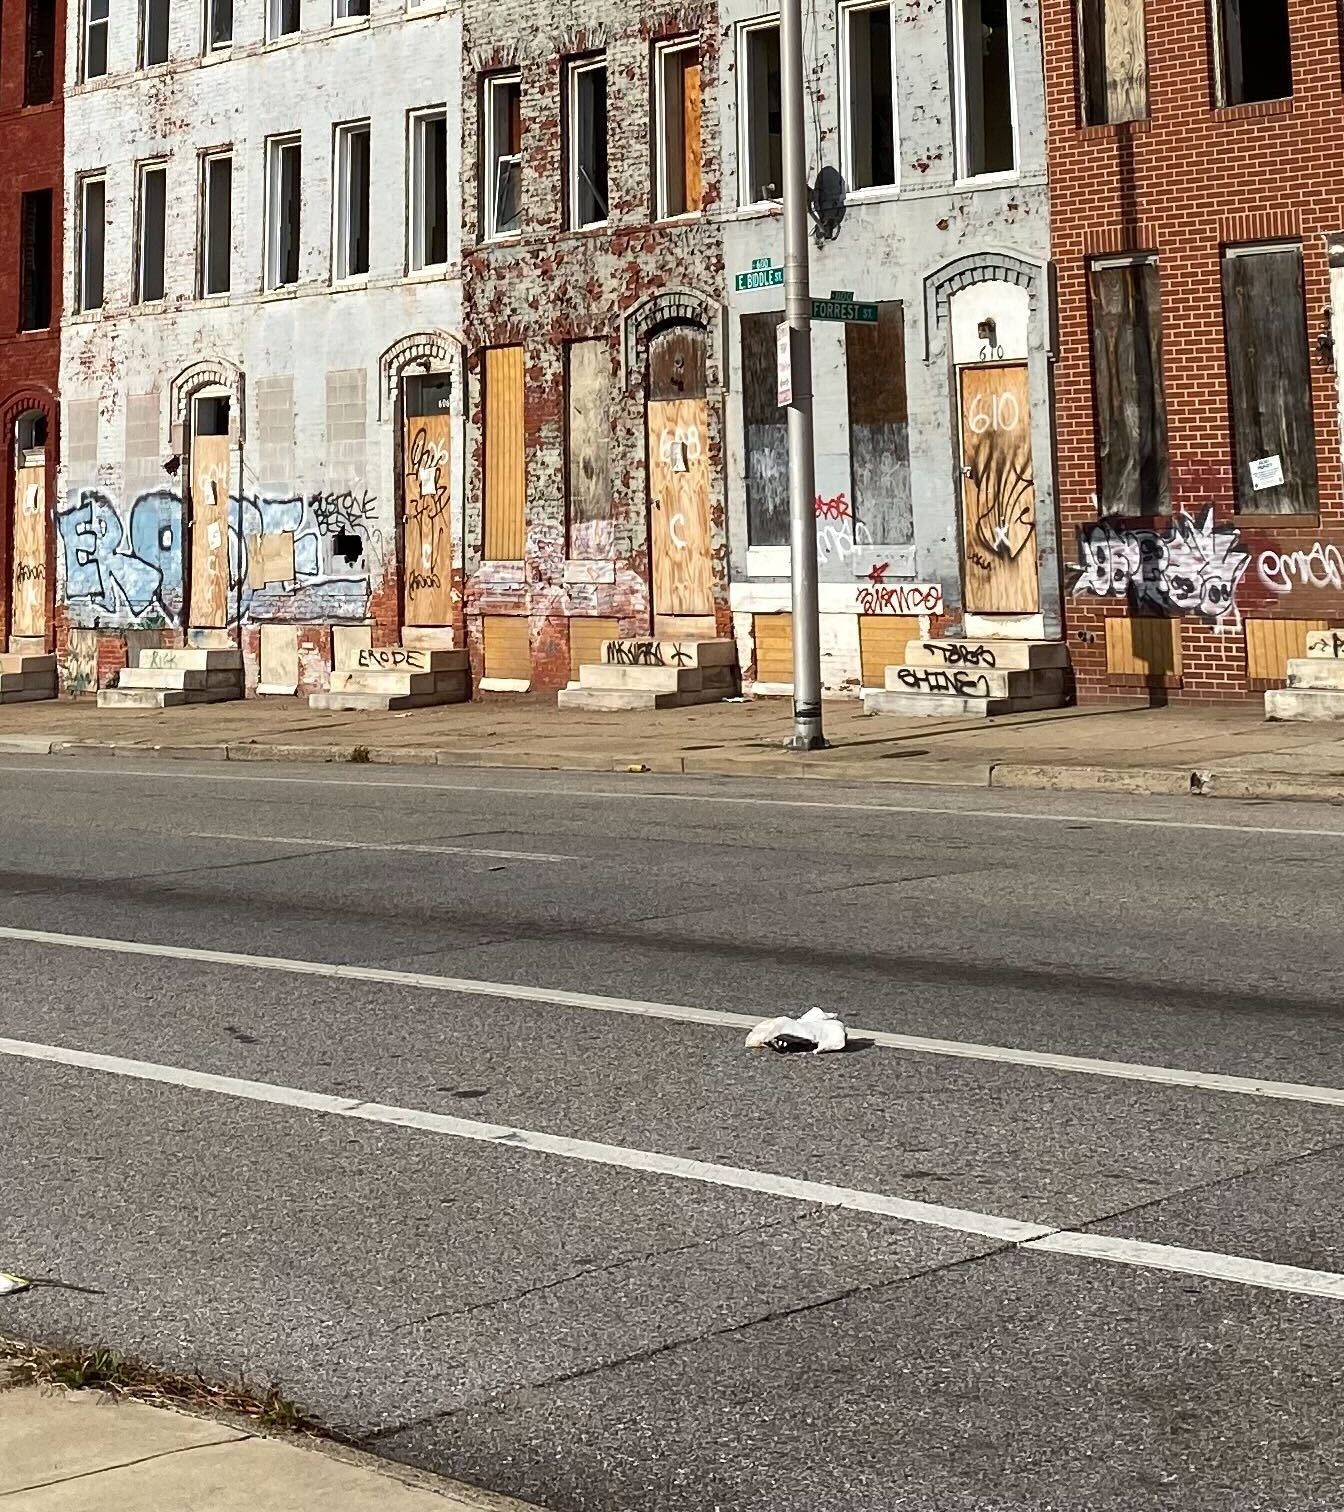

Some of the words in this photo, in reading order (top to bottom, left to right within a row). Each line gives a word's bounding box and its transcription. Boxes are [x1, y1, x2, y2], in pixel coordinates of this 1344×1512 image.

[747, 270, 774, 289] BIDDLE
[813, 302, 860, 320] FORREST
[979, 344, 1004, 362] 610
[968, 391, 1019, 434] 610
[358, 649, 426, 670] ERODE
